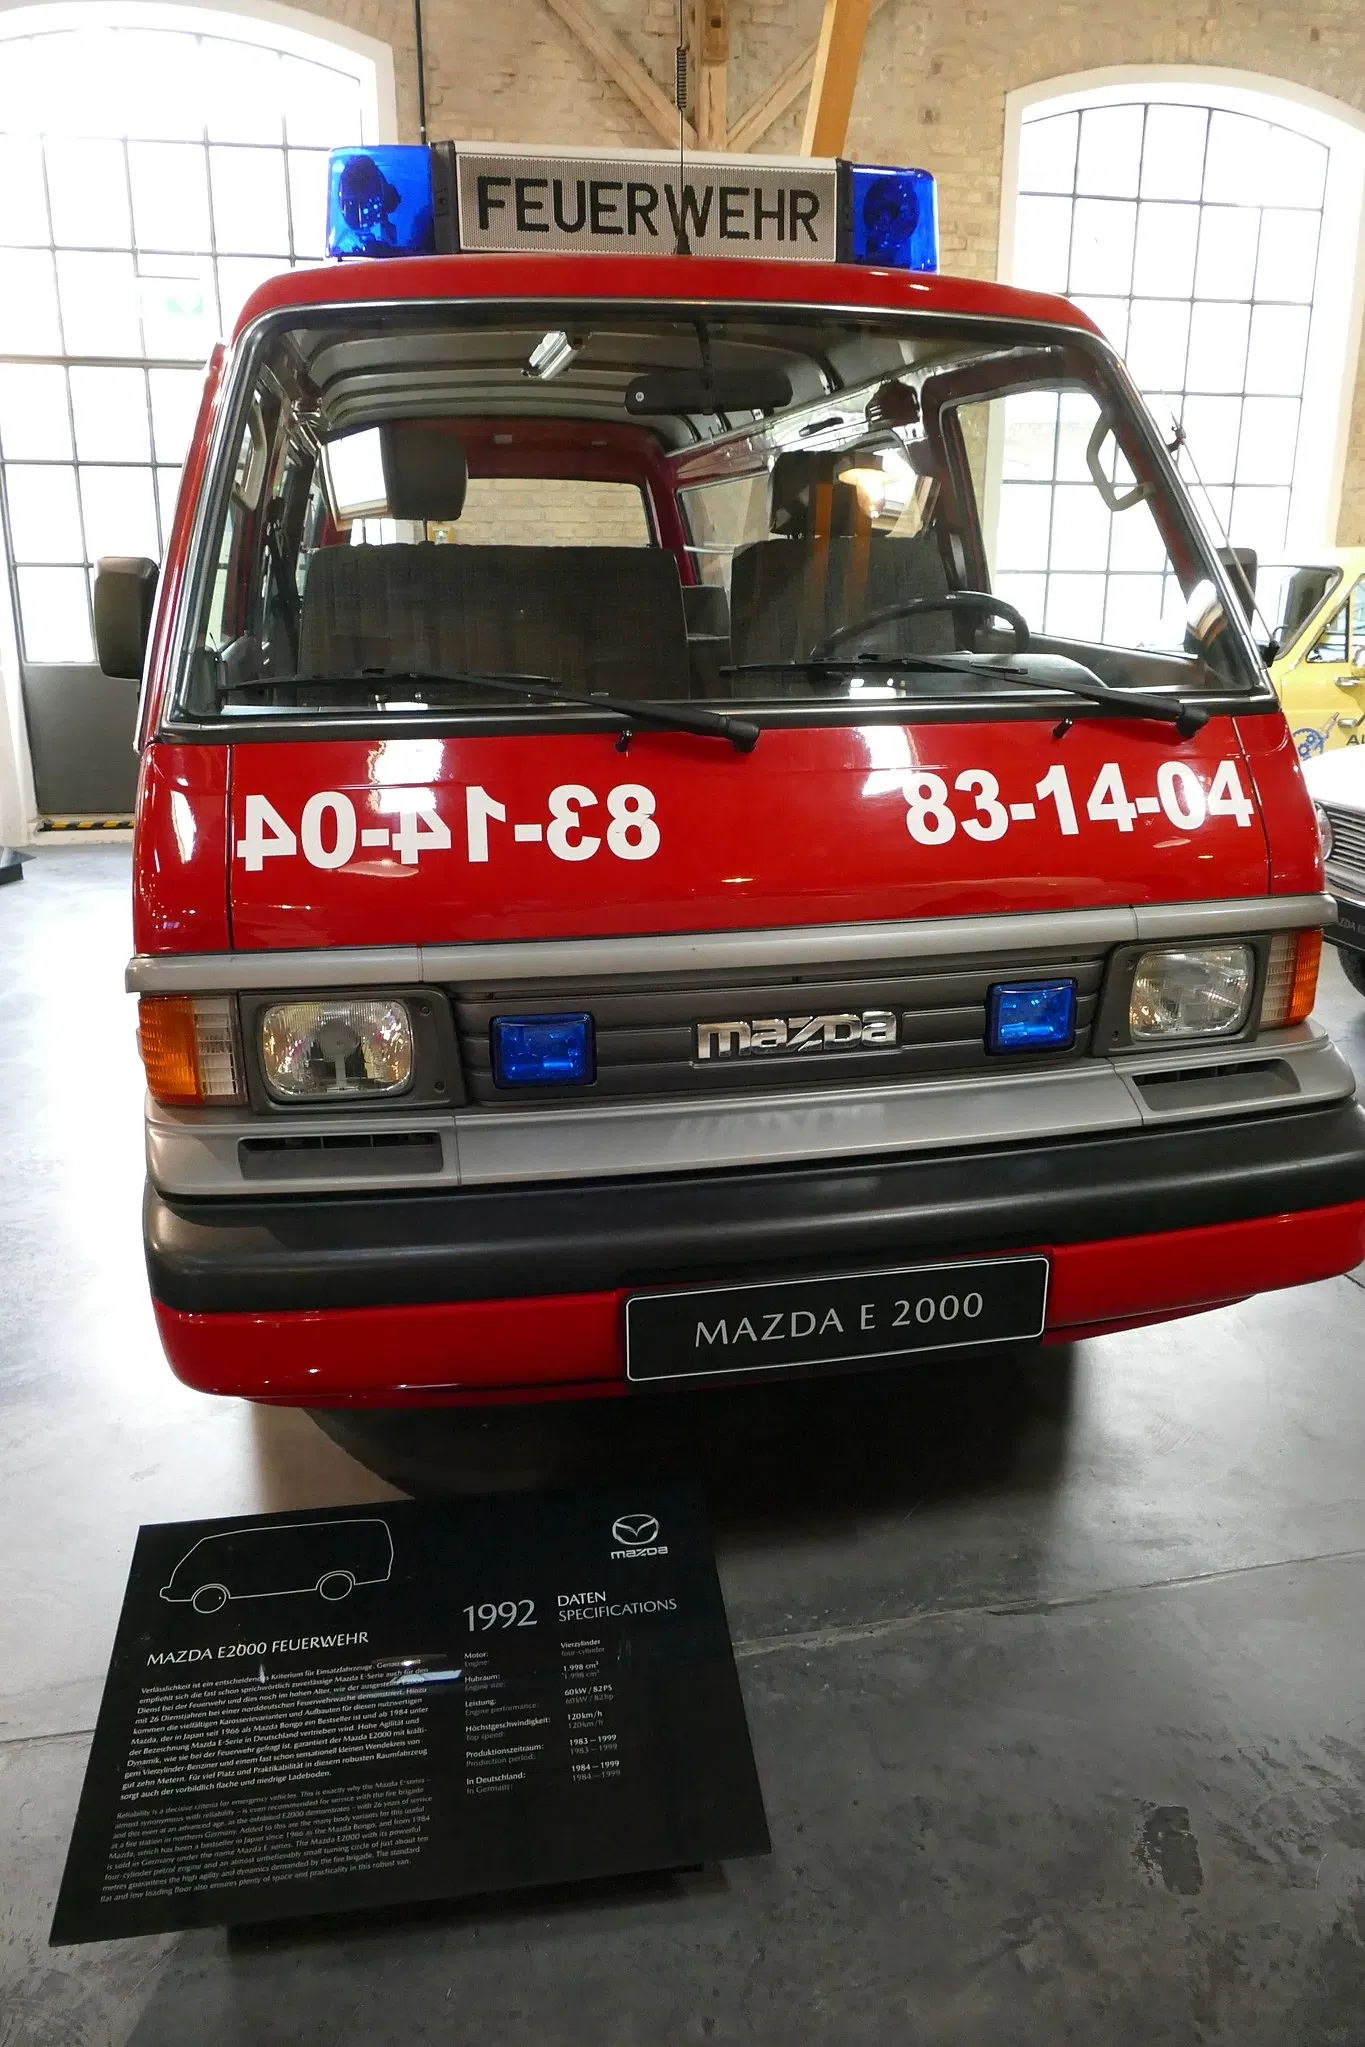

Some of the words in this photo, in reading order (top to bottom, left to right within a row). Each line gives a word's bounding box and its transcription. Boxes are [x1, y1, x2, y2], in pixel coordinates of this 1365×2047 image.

[477, 175, 821, 243] FEUERWEHR
[902, 760, 1254, 846] 83-14-04
[695, 1308, 844, 1348] MAZDA
[859, 1303, 876, 1330] E
[891, 1292, 984, 1327] 2000
[557, 1590, 607, 1607] DATEN
[463, 1599, 538, 1632] 1992
[558, 1598, 678, 1623] SPECIFICATIONS
[146, 1647, 213, 1667] MAZDA
[217, 1641, 267, 1660] E2000
[271, 1631, 369, 1653] FEUERWEHR
[561, 1640, 600, 1648] Vierzylinder
[466, 1716, 550, 1732] Höchstgeschwindigkeit:
[570, 1738, 587, 1746] 1983
[599, 1734, 616, 1742] 1999
[466, 1745, 544, 1758] Produktionszeitraum:
[572, 1764, 590, 1772] 1984
[602, 1760, 619, 1768] 1999
[476, 1772, 525, 1784] Deutschland:
